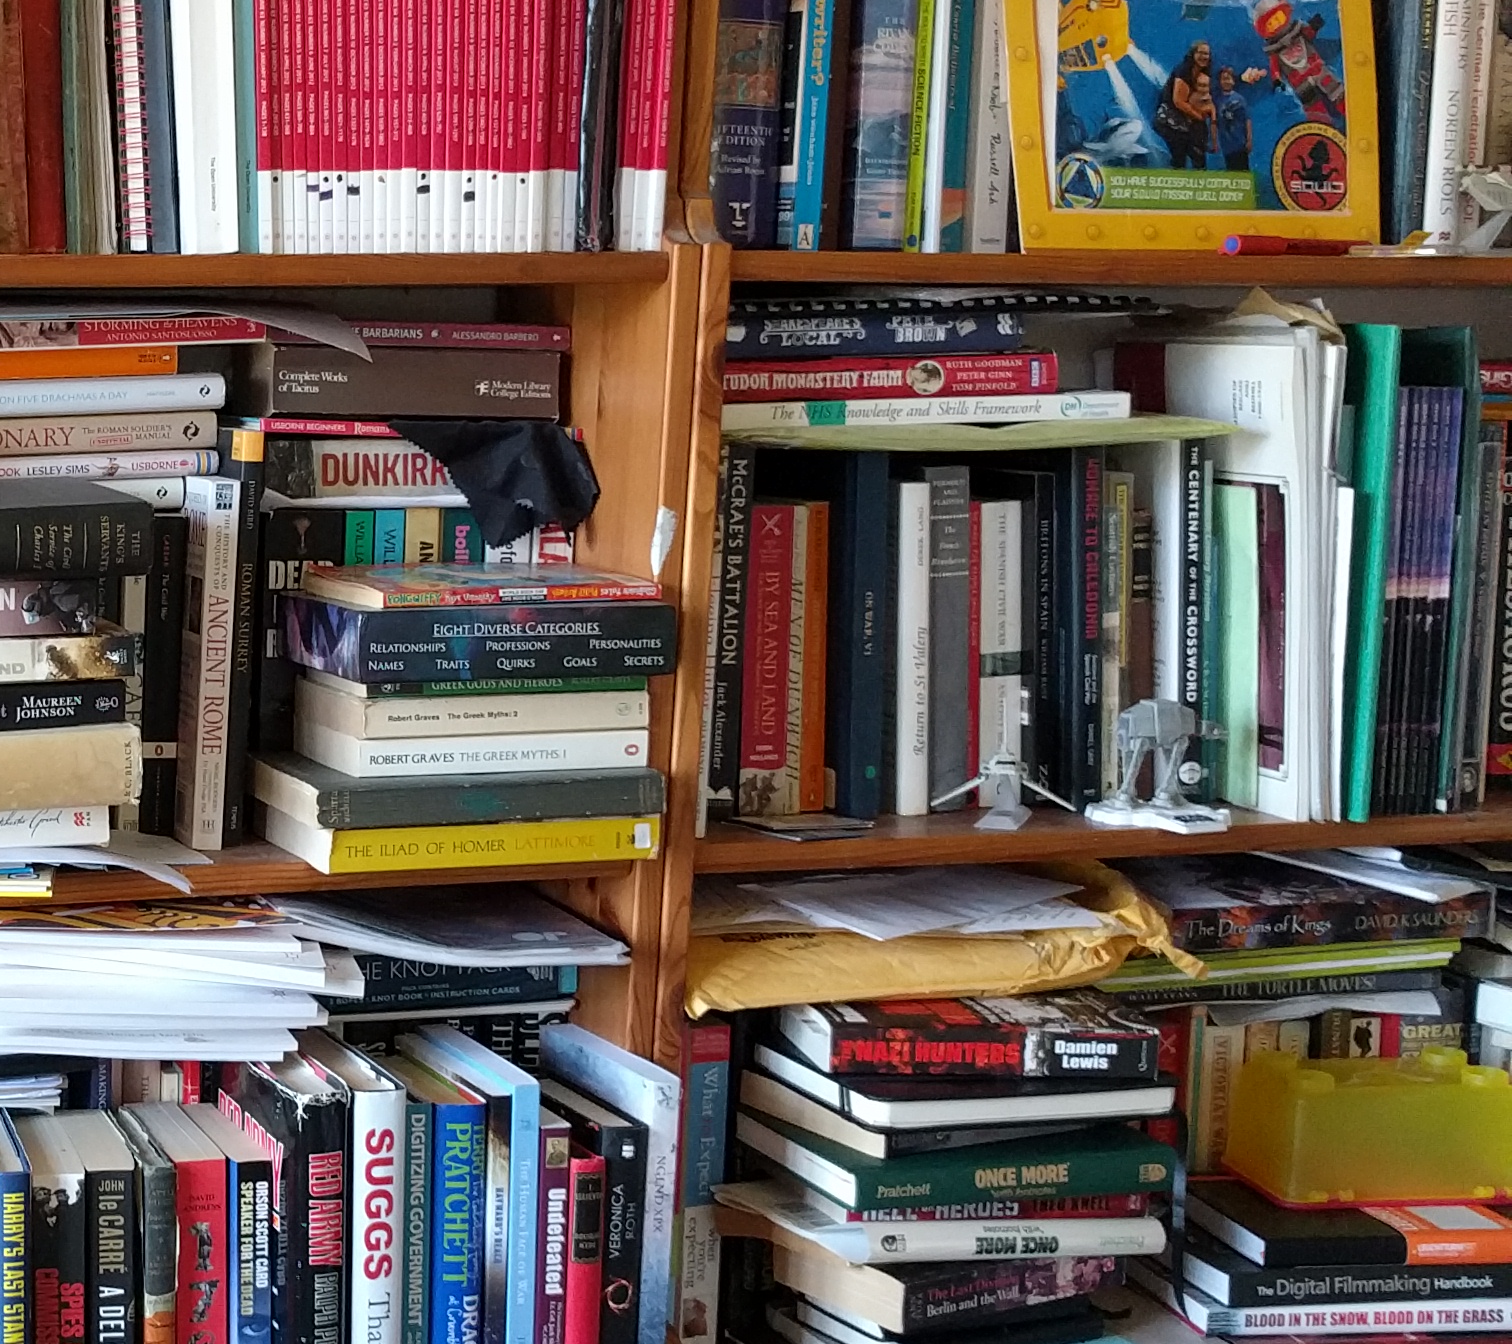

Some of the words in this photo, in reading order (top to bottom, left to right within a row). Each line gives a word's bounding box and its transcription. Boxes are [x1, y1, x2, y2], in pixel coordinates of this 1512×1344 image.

[345, 844, 374, 858] THE
[379, 841, 420, 857] ILIAD
[425, 840, 446, 855] OF
[452, 837, 507, 854] HOMER
[1054, 1040, 1118, 1057] Damien
[1061, 1053, 1109, 1071] Lewis
[363, 1127, 395, 1281] SUGGS
[440, 1122, 472, 1288] PRATCHETT
